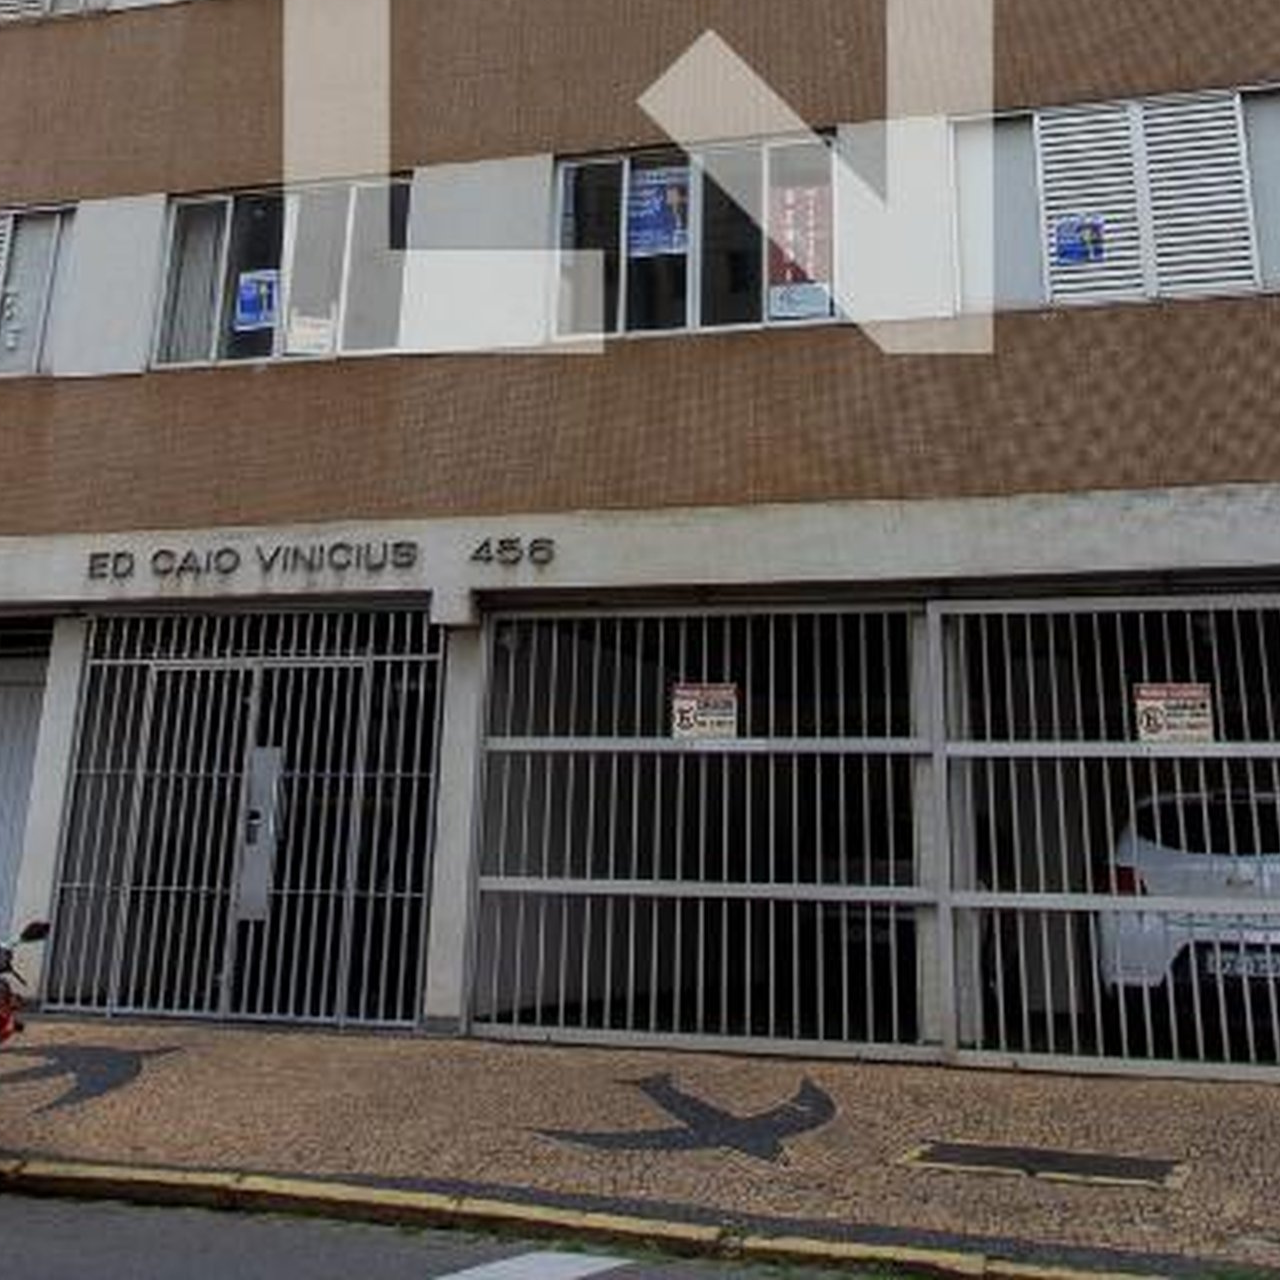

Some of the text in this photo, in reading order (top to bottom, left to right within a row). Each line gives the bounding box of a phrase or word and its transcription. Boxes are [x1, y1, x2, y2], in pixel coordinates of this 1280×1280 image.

[89, 537, 555, 580] ED CAIO VINICIUS 456
